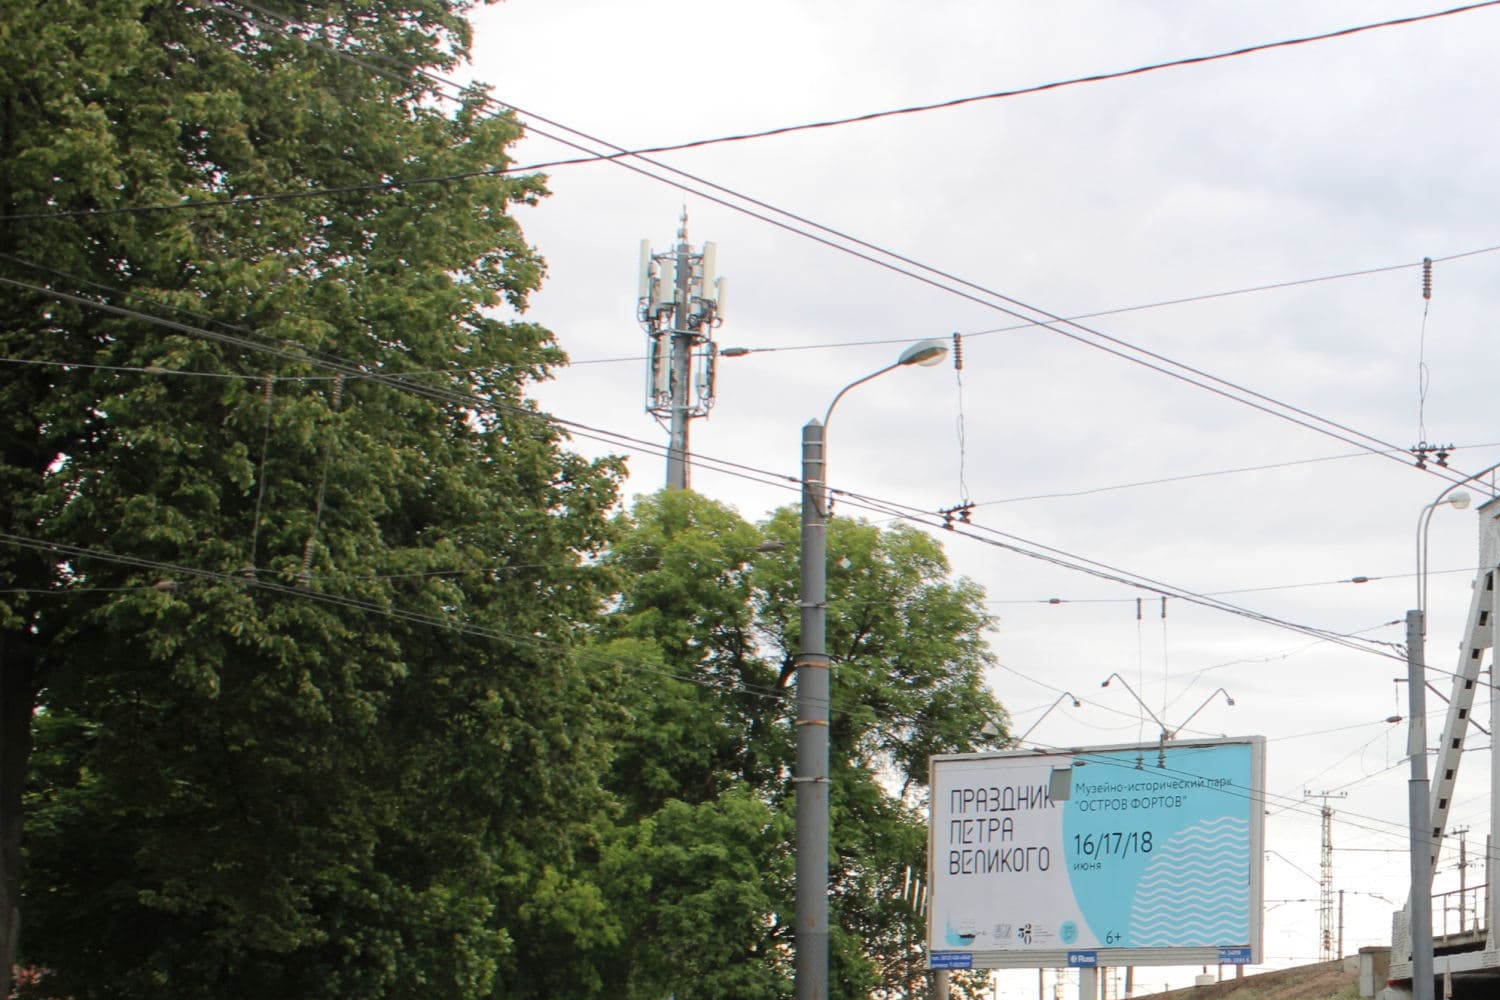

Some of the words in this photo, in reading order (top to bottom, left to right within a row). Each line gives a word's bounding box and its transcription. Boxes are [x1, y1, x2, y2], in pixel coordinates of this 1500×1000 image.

[1075, 779, 1204, 796] Музейно-исторический
[951, 784, 1055, 814] ПРАЗДНИК
[1075, 799, 1127, 812] "ОСТРОВ
[1131, 796, 1187, 809] ФОРТОВ"
[950, 817, 1014, 845] ПЕТРА
[1074, 831, 1153, 860] 16/17/18
[949, 846, 1050, 875] ВЕЛИКОГО
[1074, 862, 1102, 871] июня
[1106, 931, 1122, 945] 6+
